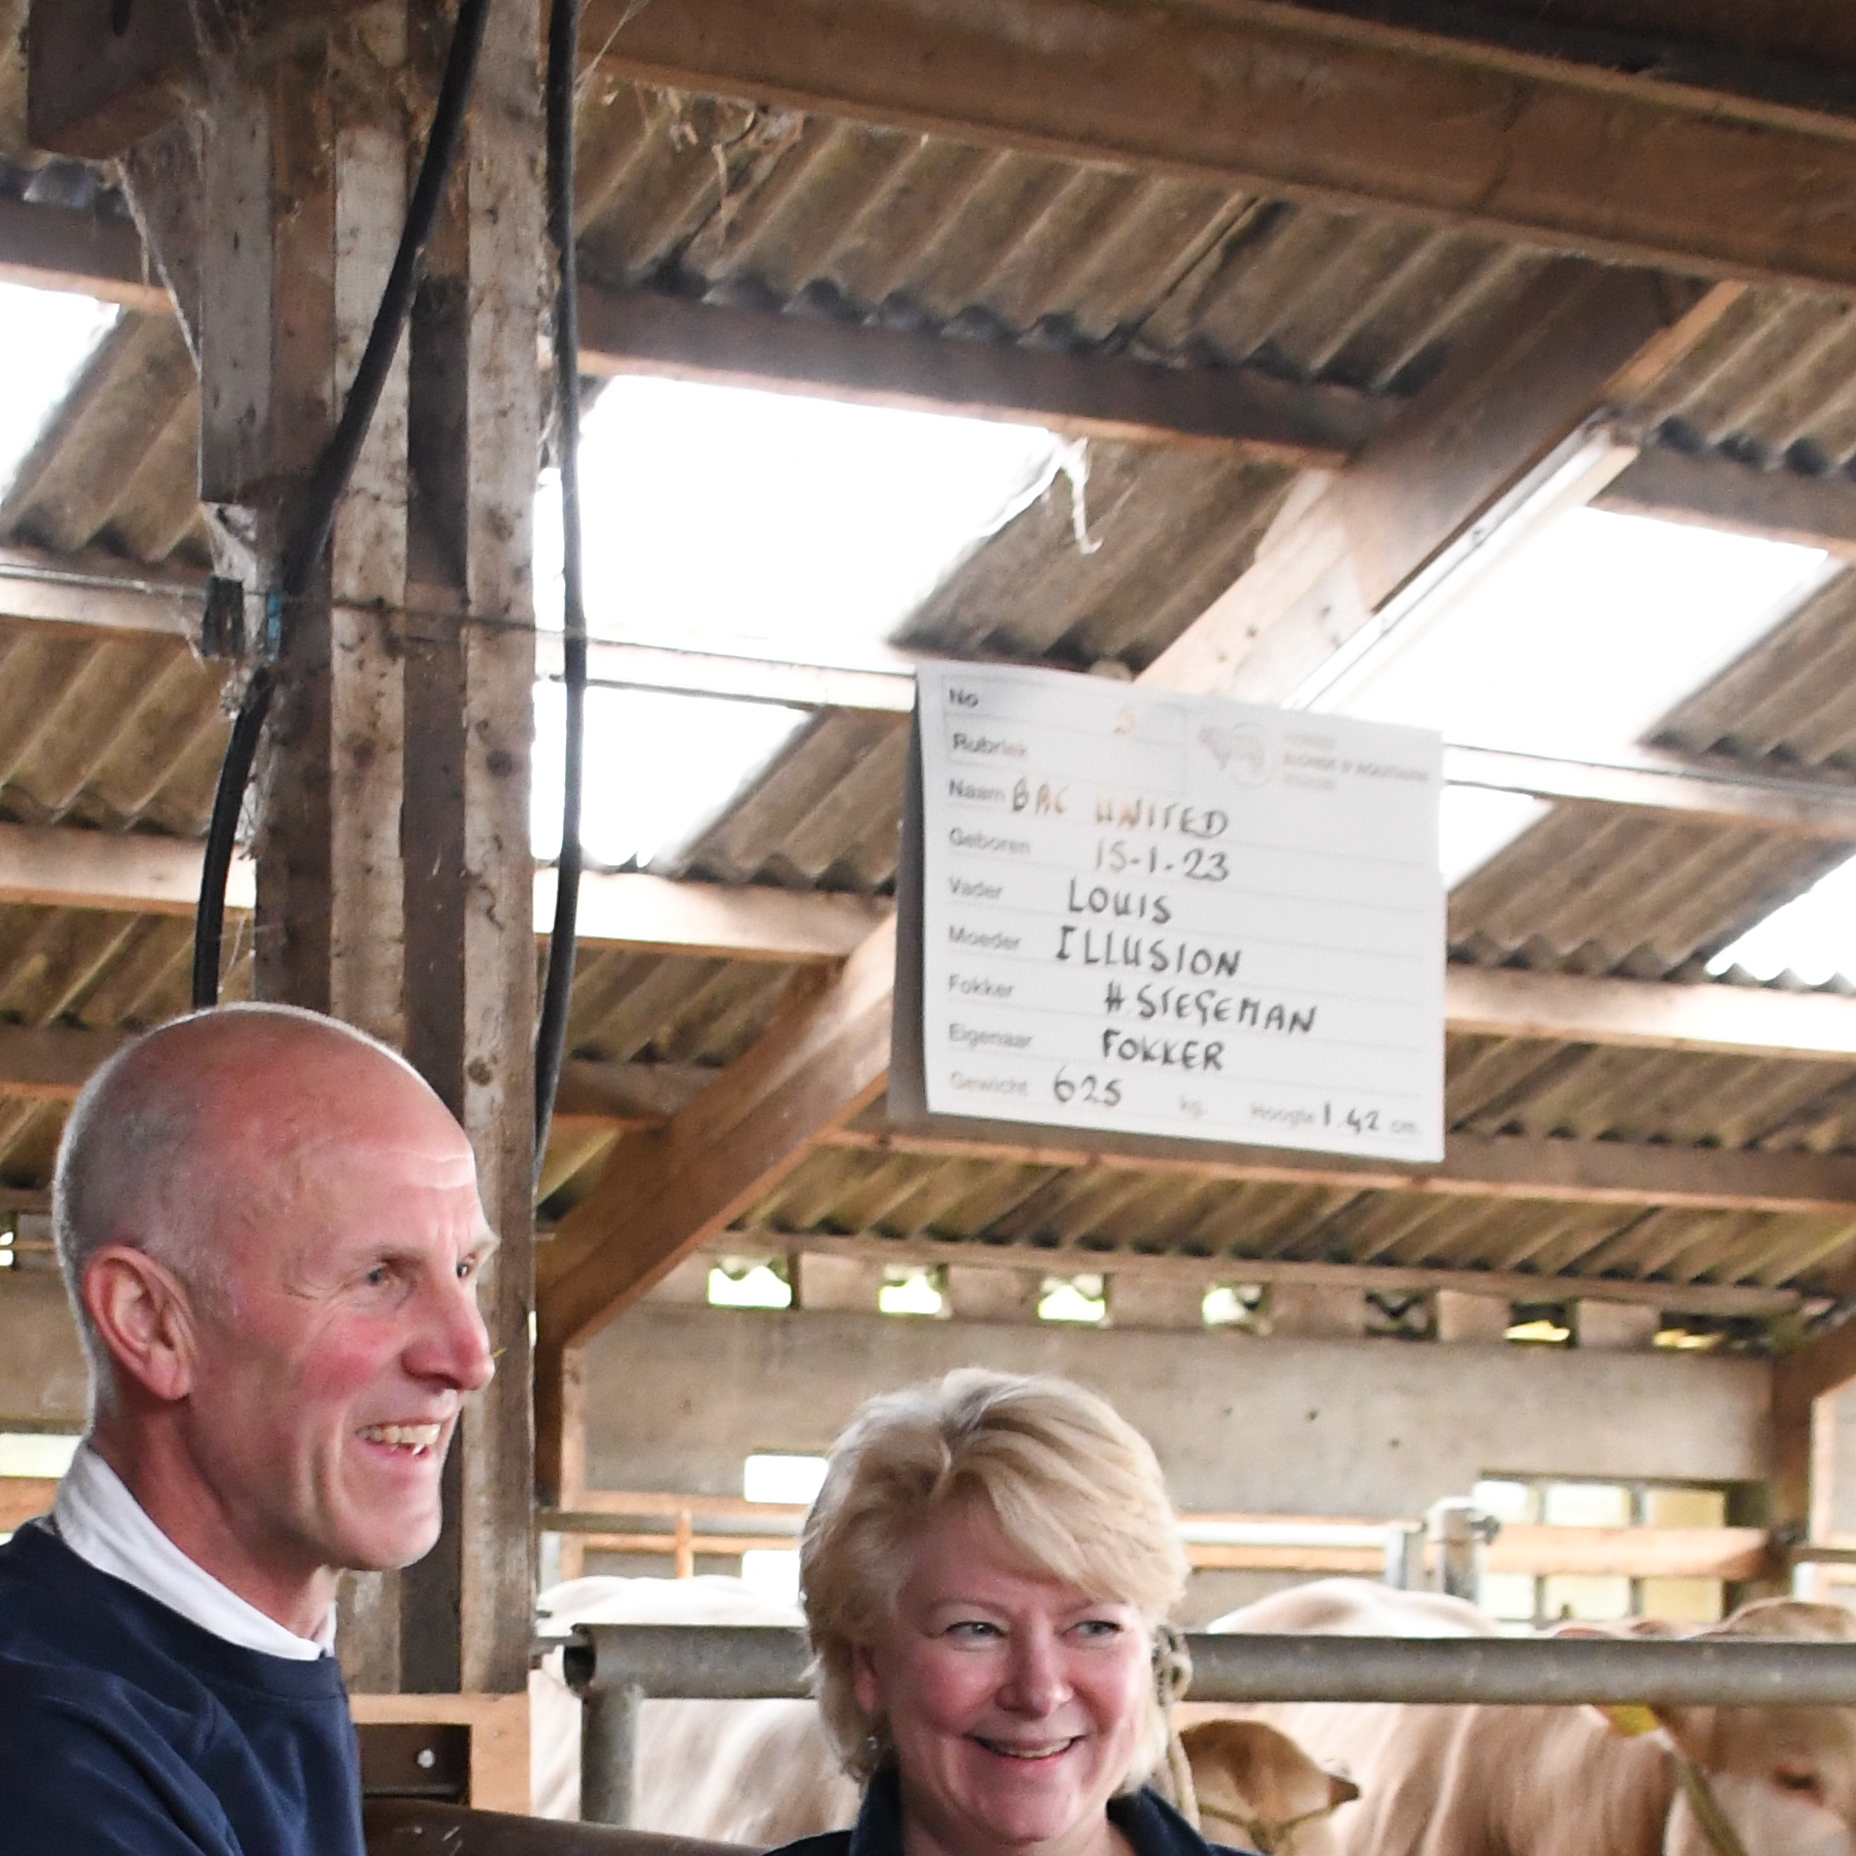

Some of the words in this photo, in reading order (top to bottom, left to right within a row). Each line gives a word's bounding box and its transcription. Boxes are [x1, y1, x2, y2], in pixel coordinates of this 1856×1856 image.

[1011, 777, 1069, 816] BAC
[1096, 797, 1230, 839] UNITED
[1068, 876, 1173, 925] LOUIS
[1054, 924, 1244, 978] ILLUSION
[1137, 983, 1319, 1035] STEGEMAN
[1101, 1028, 1226, 1072] FOKKER
[1053, 1064, 1124, 1108] 625
